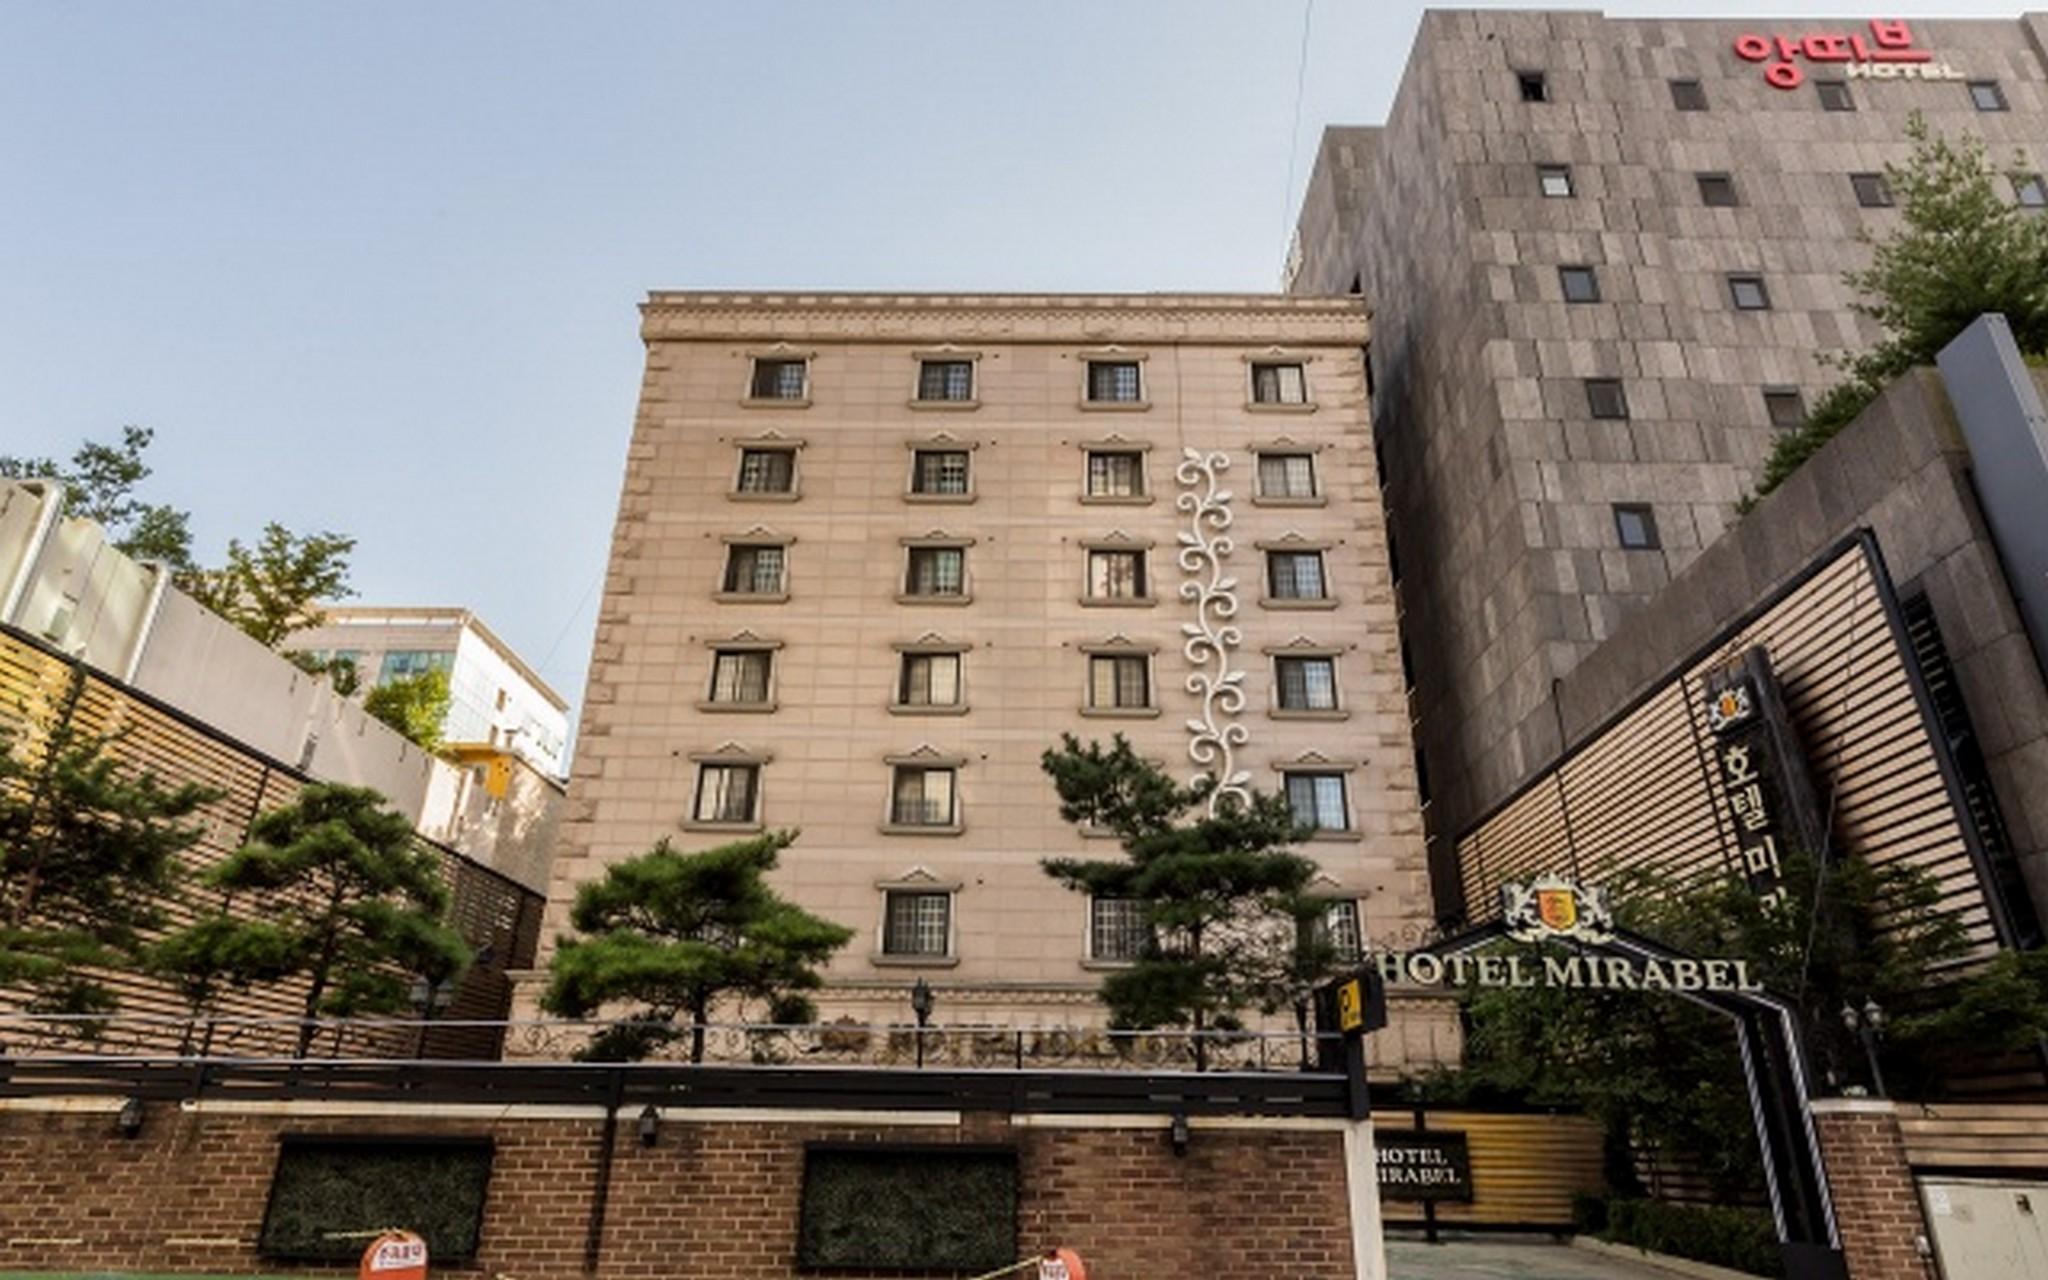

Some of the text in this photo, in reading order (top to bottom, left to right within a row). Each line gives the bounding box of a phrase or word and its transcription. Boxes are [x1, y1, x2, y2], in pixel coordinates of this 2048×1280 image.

[1845, 61, 1966, 81] HOTEL
[1375, 952, 1764, 992] HOTEL MIRABEL
